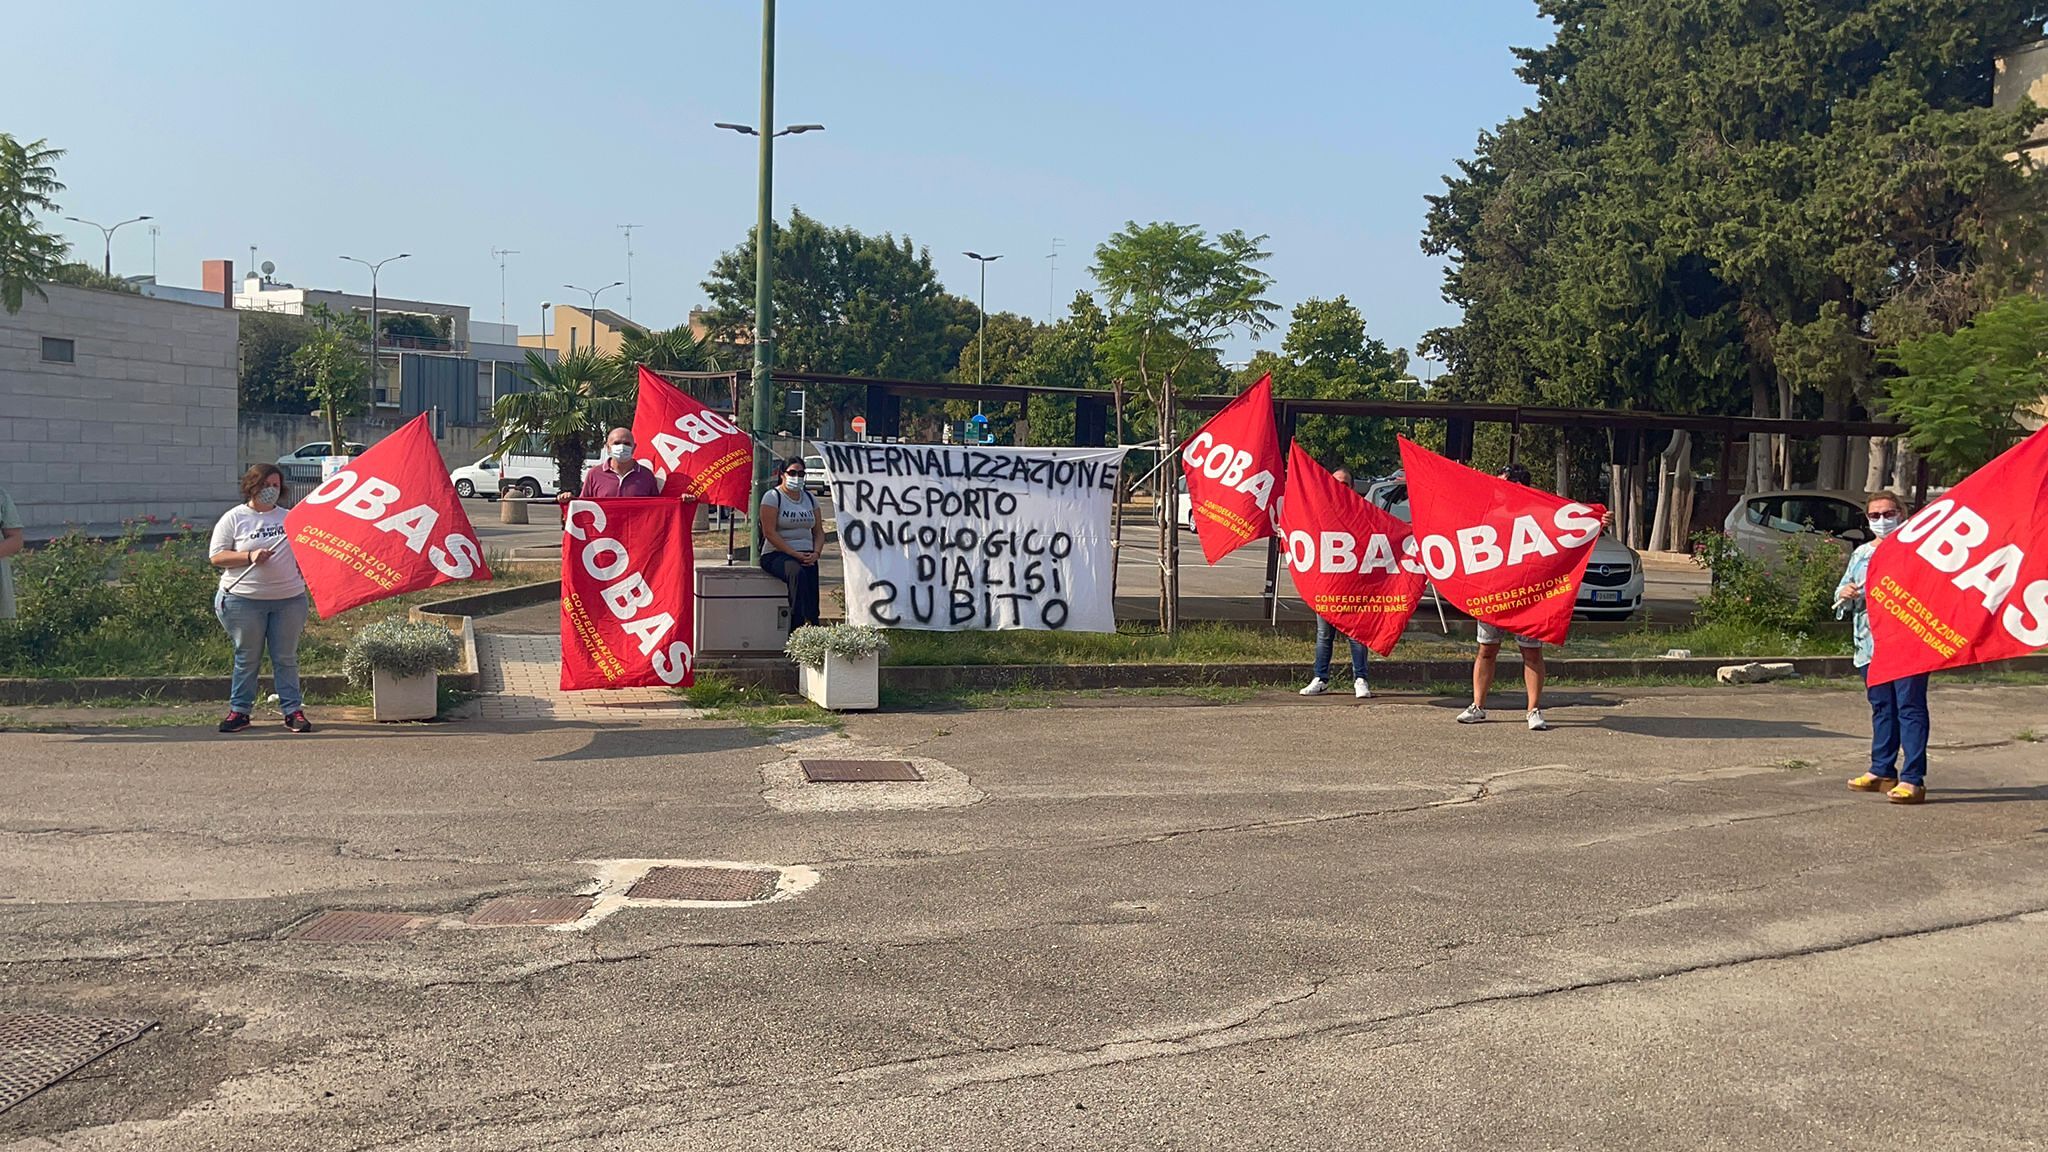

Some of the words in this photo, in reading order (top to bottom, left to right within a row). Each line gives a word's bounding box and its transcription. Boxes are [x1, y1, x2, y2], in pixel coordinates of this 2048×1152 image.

[825, 446, 1119, 490] INTERNALIZZAZIONE
[305, 470, 482, 579] OBAS
[833, 480, 1018, 520] TRASPORTO
[295, 534, 311, 545] DEI
[309, 540, 354, 565] COMITATI
[352, 562, 366, 573] DI
[364, 569, 394, 591] BASE
[302, 525, 402, 582] CONFEDERAZIONE
[844, 519, 1072, 559] ONCOLOGICO
[1420, 503, 1601, 580] OBAS
[565, 500, 692, 685] COBAS
[917, 554, 1061, 594] DIALISI
[1315, 594, 1408, 603] CONFEDERAZIONE
[1466, 574, 1570, 606] CONFEDERAZIONE
[1469, 608, 1483, 617] DEI
[1485, 597, 1532, 614] COMITATI
[1533, 593, 1544, 602] DI
[1545, 583, 1573, 599] BASE
[1896, 499, 2048, 647] OBAS
[868, 580, 1069, 629] SUBITO
[1315, 604, 1329, 612] DEI
[1330, 604, 1371, 613] COMITATI
[1373, 604, 1382, 612] DI
[1384, 604, 1408, 613] BASE
[1870, 586, 1886, 603] DEI
[1884, 599, 1927, 637] COMITATI
[1930, 638, 1957, 659] BASE
[1880, 575, 1969, 649] CONFEDERAZIONE
[562, 597, 574, 613] DEI
[570, 612, 596, 652] COMITATI
[591, 651, 602, 662] DI
[597, 659, 617, 682] BASE
[571, 593, 626, 676] CONFEDERAZIONE
